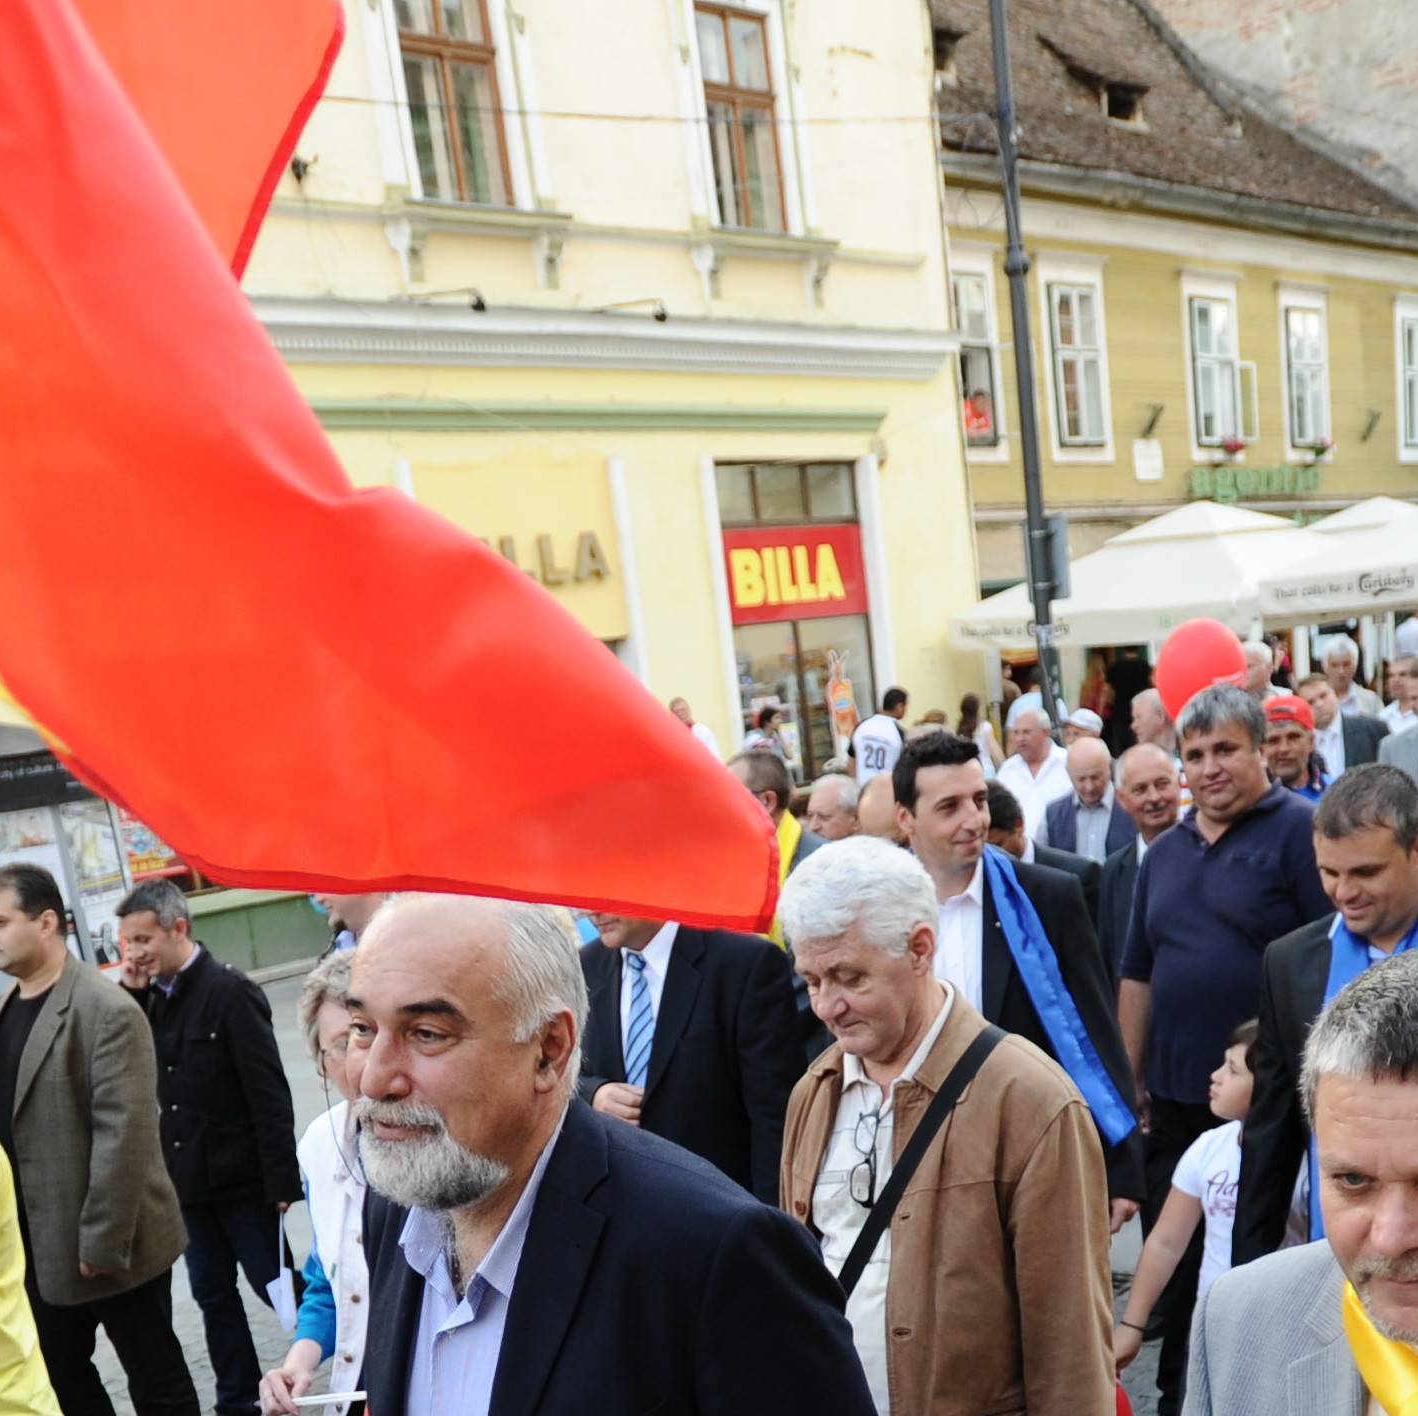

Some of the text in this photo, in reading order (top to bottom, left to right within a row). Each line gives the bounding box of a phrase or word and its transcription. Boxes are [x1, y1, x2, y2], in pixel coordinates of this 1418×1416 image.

[729, 543, 846, 608] BILLA
[1358, 567, 1415, 596] Carlsberg
[864, 743, 886, 770] 20
